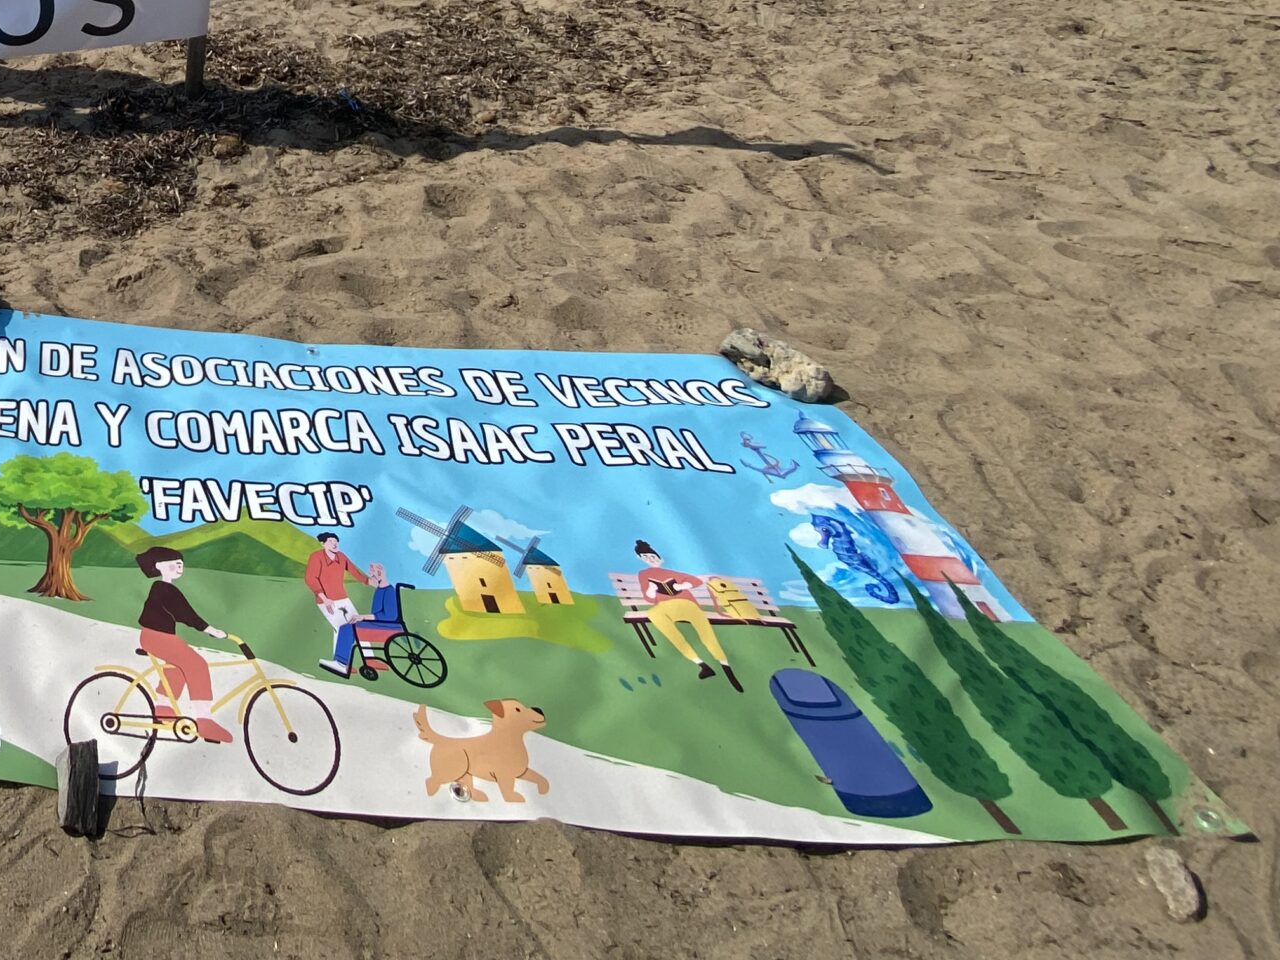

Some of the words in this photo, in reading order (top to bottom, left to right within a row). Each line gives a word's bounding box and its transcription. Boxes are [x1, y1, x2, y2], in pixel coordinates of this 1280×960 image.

[39, 341, 98, 381] DE
[113, 348, 458, 398] ASOCIACIONES
[462, 367, 539, 408] DE
[536, 373, 770, 408] VECINOS
[96, 403, 131, 447] Y
[145, 408, 385, 455] COMARCA
[388, 414, 555, 465] ISAAC
[557, 422, 736, 474] PERAL
